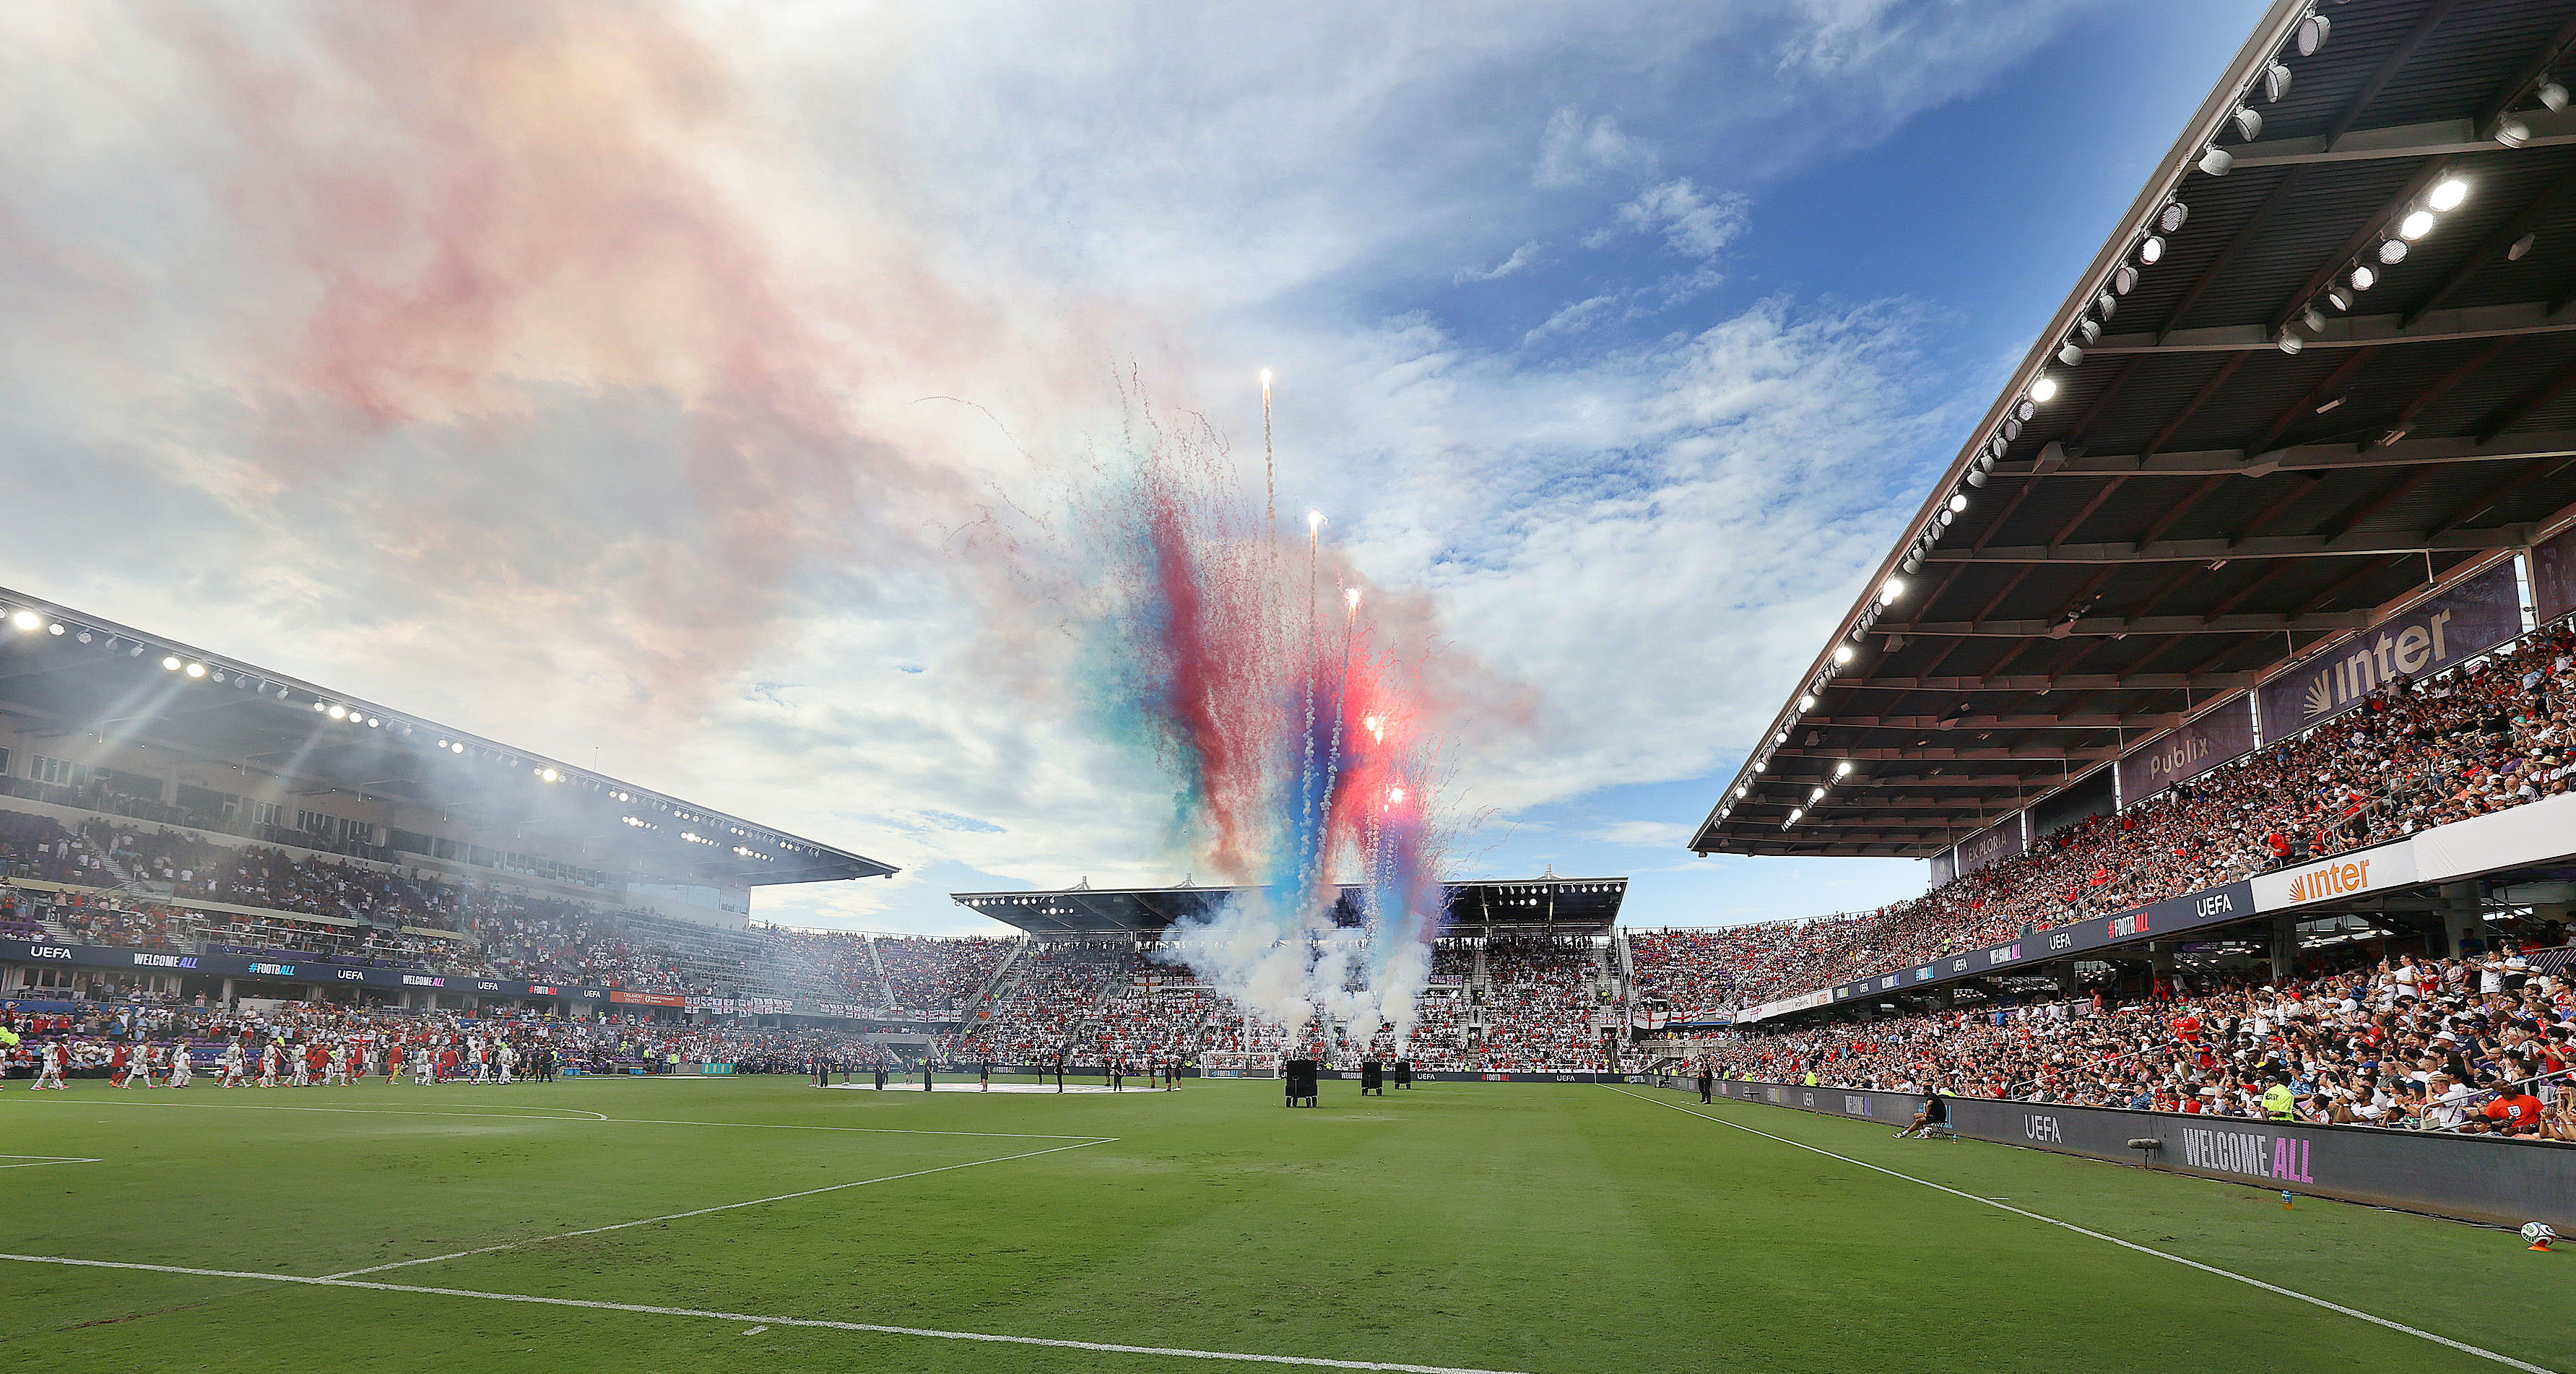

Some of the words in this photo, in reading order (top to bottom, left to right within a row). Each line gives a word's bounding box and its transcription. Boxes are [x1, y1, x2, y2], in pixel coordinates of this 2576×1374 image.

[2151, 737, 2209, 780] Publix
[1968, 831, 2008, 863] EXPLORIA
[2195, 893, 2234, 917] UEFA
[2107, 912, 2151, 939] #FOOTBALL
[2049, 932, 2072, 950] UEFA
[30, 946, 71, 959] UEFA
[1990, 946, 2012, 965] WELCOME
[2011, 943, 2022, 960] ALL
[134, 953, 179, 967] WELCOME
[179, 957, 198, 969] ALL
[1952, 958, 1968, 972] UEFA
[248, 962, 295, 976] #FOOTBALL
[337, 969, 364, 980] UEFA
[403, 975, 433, 987] WELCOME
[432, 977, 446, 988] ALL
[477, 981, 499, 991] UEFA
[529, 985, 558, 996] #FOOTBALL
[584, 990, 601, 998] UEFA
[1802, 1092, 1816, 1107] UEFA
[2024, 1114, 2063, 1144] UEFA
[2183, 1128, 2270, 1178] WELCOME
[2272, 1137, 2314, 1184] ALL
